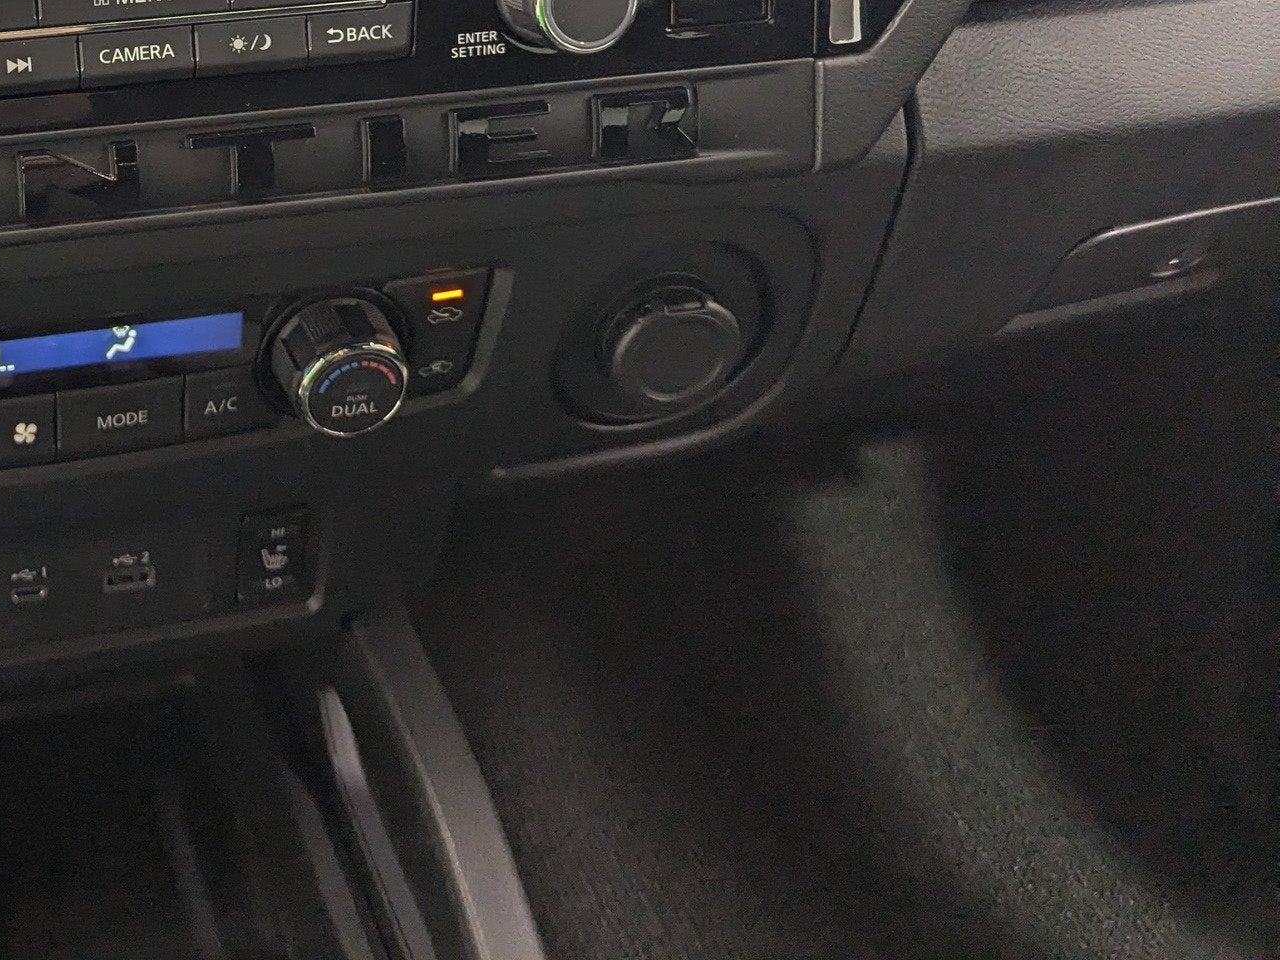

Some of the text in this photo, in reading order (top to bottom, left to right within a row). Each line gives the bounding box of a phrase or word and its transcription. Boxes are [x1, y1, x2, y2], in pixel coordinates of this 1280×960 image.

[346, 24, 394, 43] BACK
[457, 31, 499, 46] ENTER
[98, 43, 177, 66] CAMERA
[451, 44, 506, 59] SETTING
[204, 395, 238, 417] A/C
[331, 401, 379, 418] DUAL
[96, 410, 149, 431] MODE
[265, 576, 283, 589] LO
